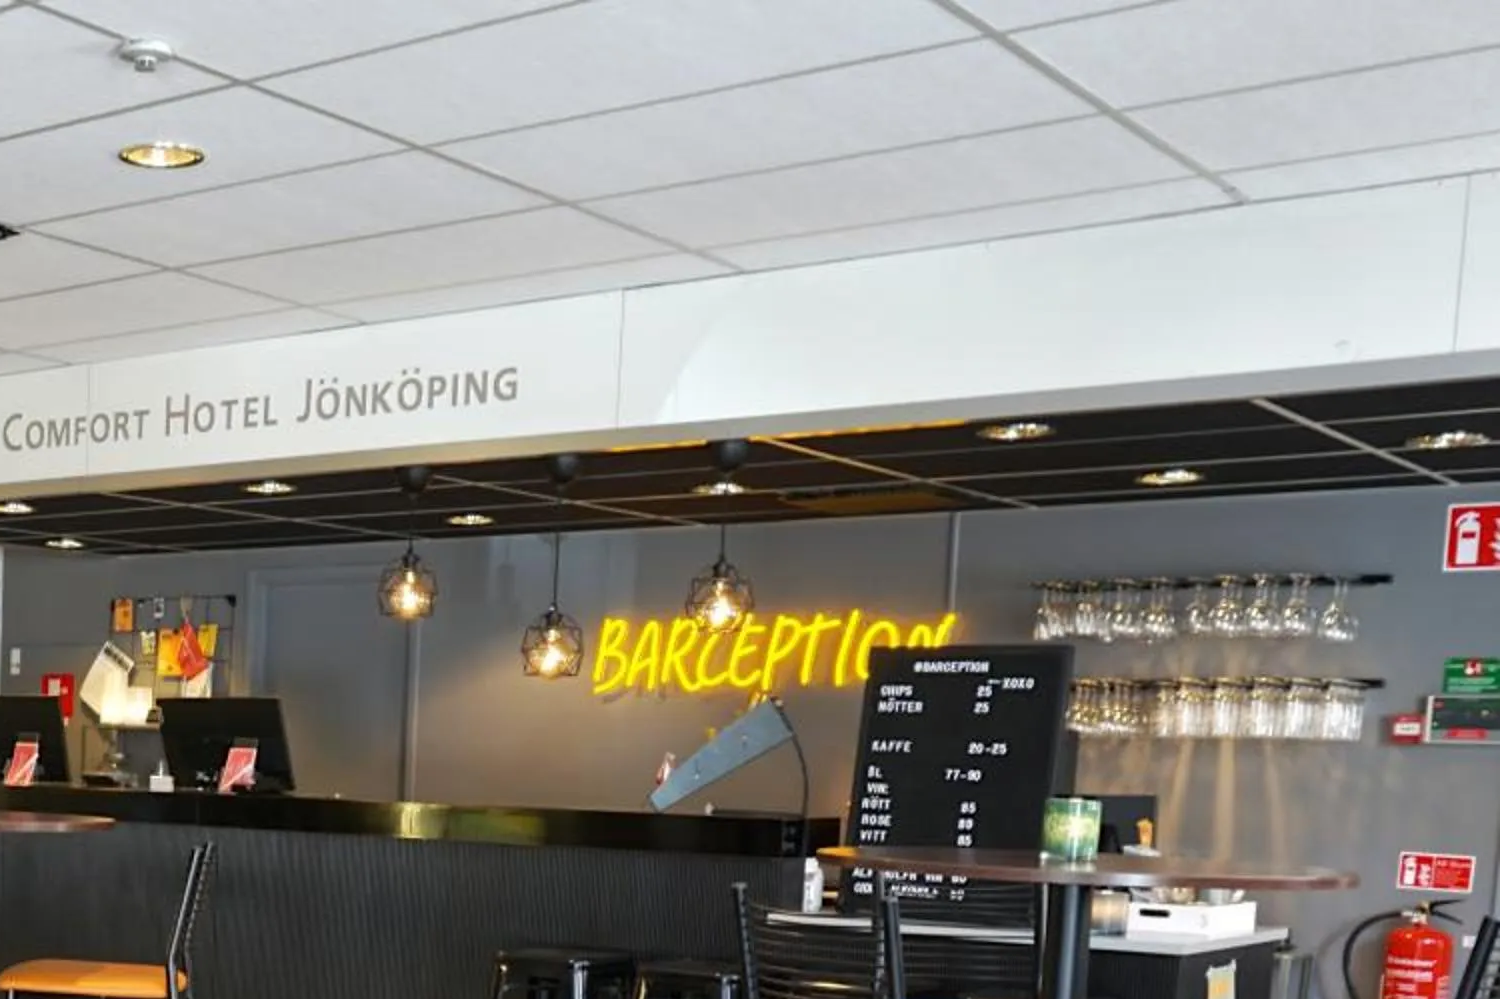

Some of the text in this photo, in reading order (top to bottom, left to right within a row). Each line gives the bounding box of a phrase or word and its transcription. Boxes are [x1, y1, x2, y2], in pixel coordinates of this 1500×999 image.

[3, 366, 518, 451] COMFORT HOTEL JÖNKÖPING
[880, 685, 993, 698] CHIPS 25
[877, 697, 990, 714] NÖTTER 25
[871, 740, 912, 753] KAFFE
[859, 829, 887, 842] VITT
